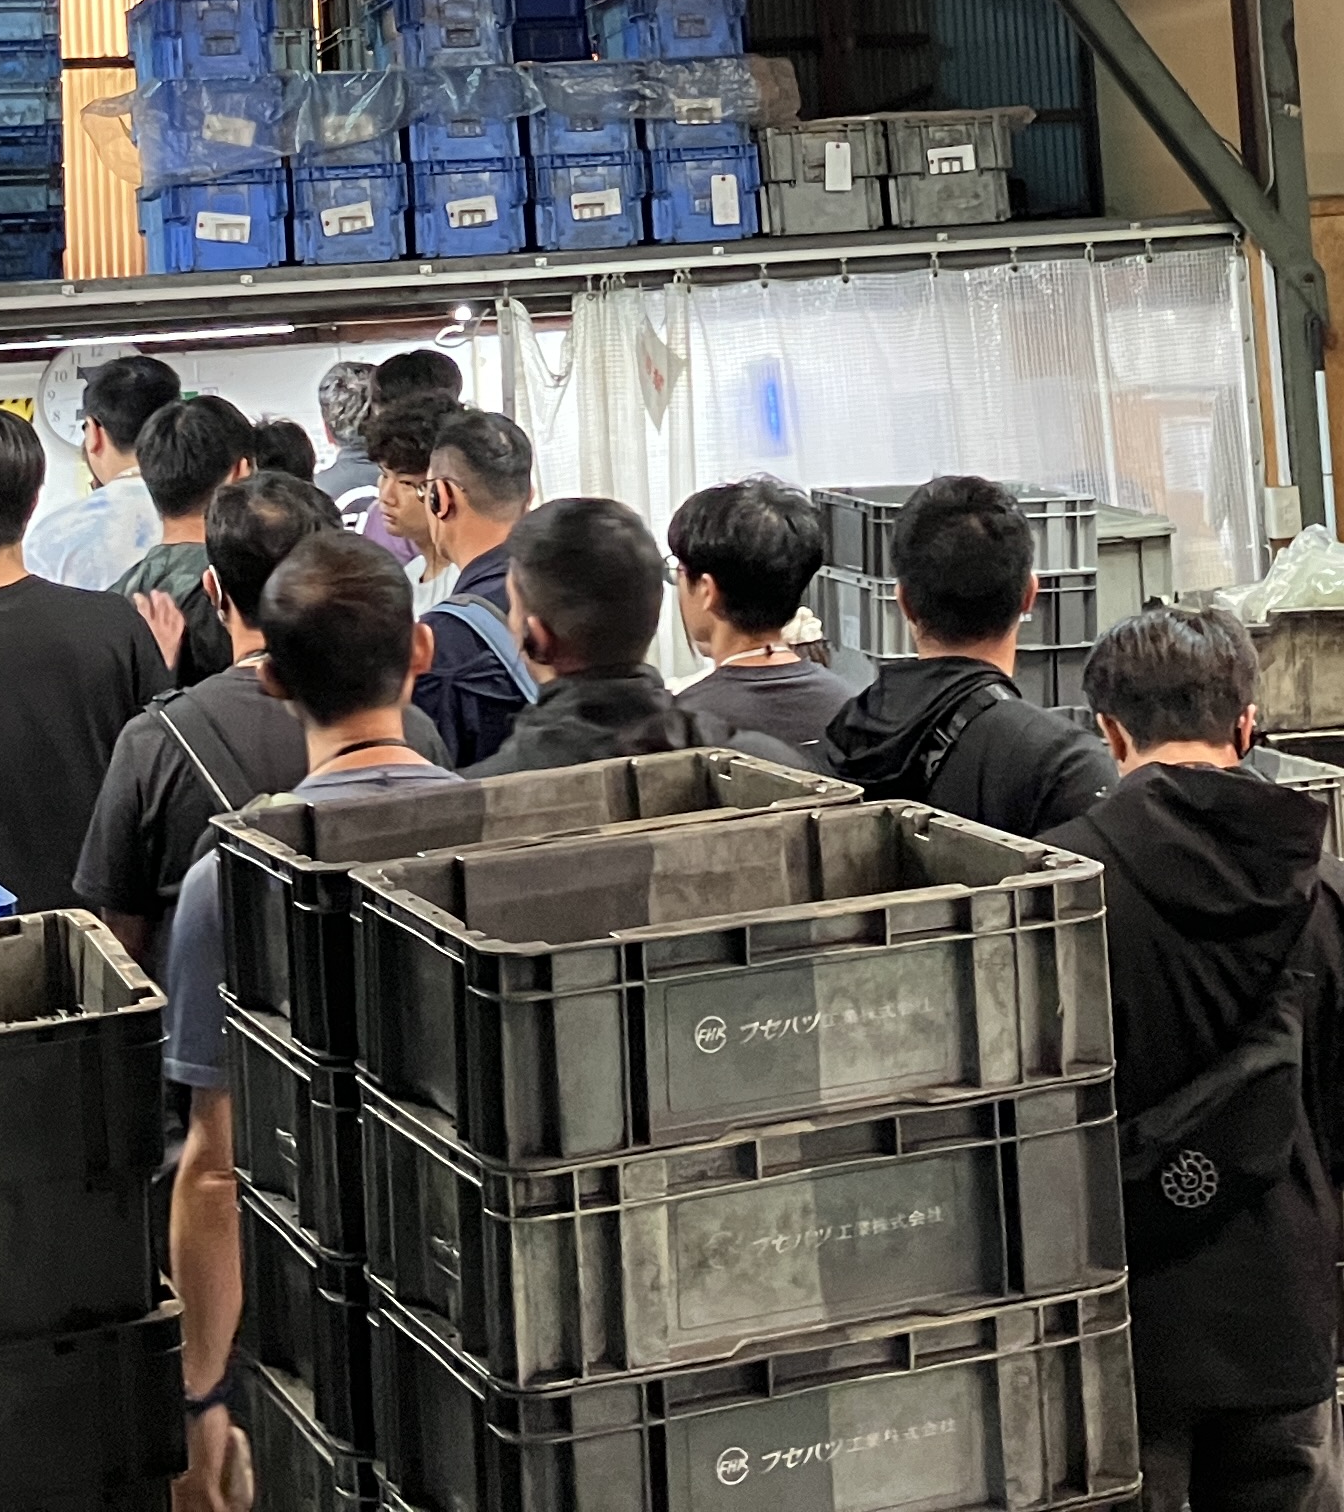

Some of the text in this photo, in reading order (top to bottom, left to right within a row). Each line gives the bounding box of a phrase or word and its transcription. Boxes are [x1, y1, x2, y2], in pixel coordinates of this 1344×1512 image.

[71, 351, 81, 365] 11
[91, 346, 103, 357] 12
[55, 370, 67, 383] 10
[48, 392, 56, 401] 9
[53, 410, 60, 423] 8
